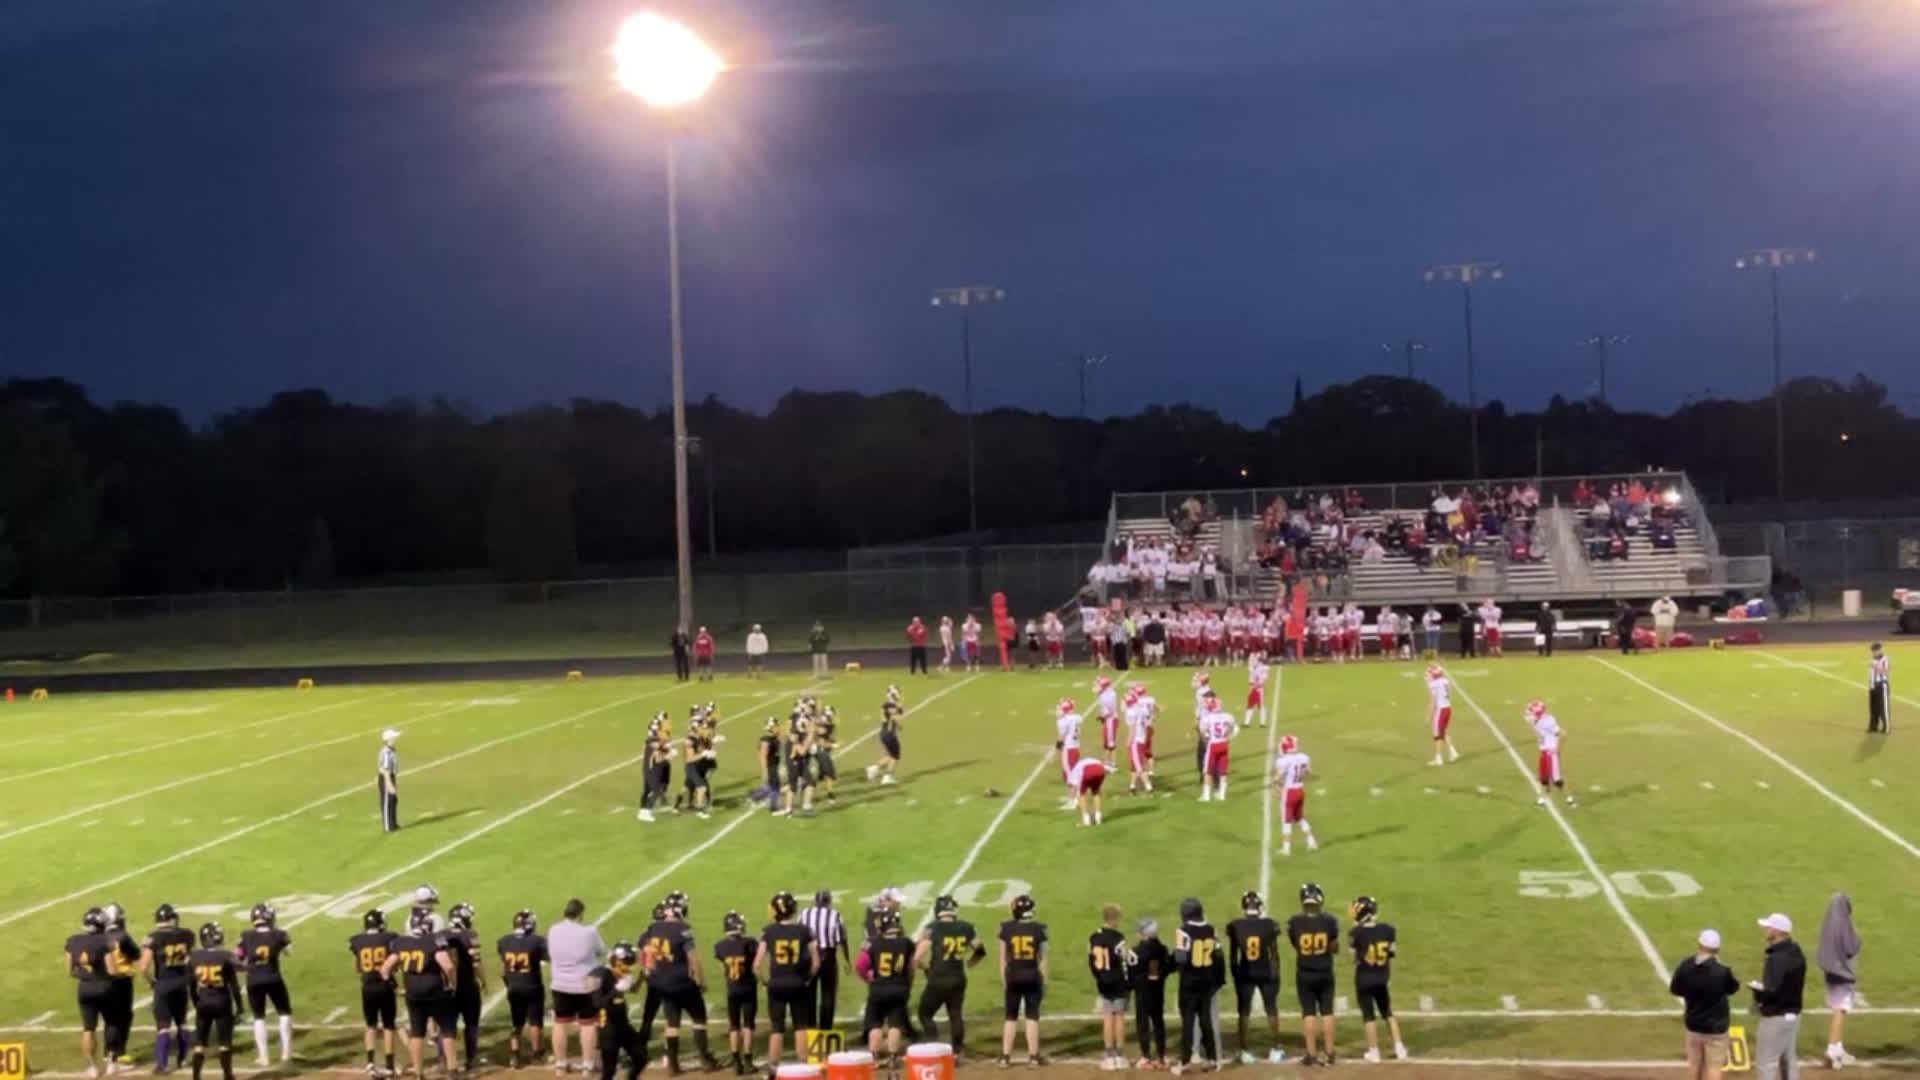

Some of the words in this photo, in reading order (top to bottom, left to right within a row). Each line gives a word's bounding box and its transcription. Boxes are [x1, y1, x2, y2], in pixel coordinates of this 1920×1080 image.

[1518, 869, 1702, 899] 50
[775, 939, 800, 965] 51
[1011, 935, 1034, 960] 15
